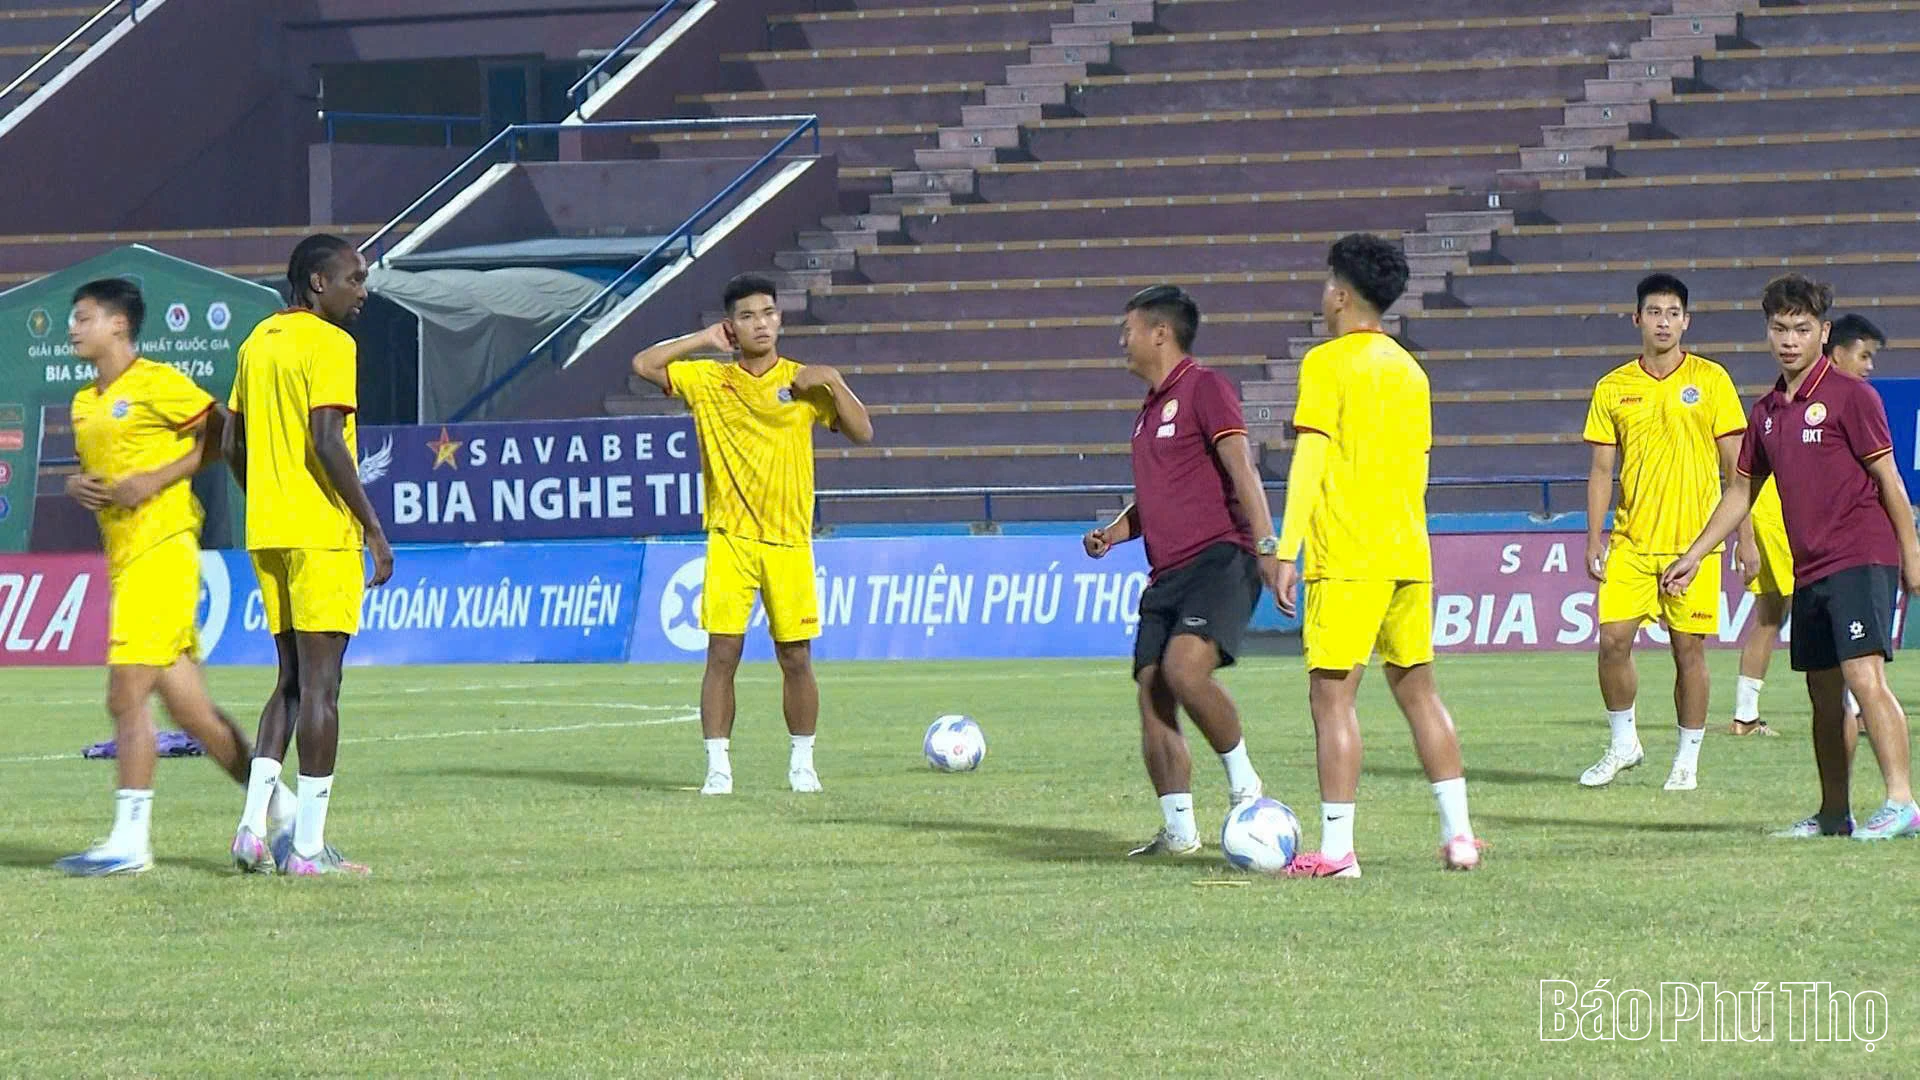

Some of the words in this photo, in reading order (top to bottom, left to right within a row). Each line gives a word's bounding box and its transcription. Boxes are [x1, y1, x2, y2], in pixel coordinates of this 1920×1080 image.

[210, 339, 230, 350] GIA
[46, 365, 71, 381] BIA
[393, 480, 477, 524] BIA
[492, 475, 633, 522] NGHE
[452, 576, 532, 628] XUÂN
[540, 576, 621, 637] THIỆN
[868, 563, 974, 636] THIỆN
[982, 561, 1063, 625] PHÚ
[1073, 571, 1147, 636] THỌ
[1433, 593, 1545, 645] BIA
